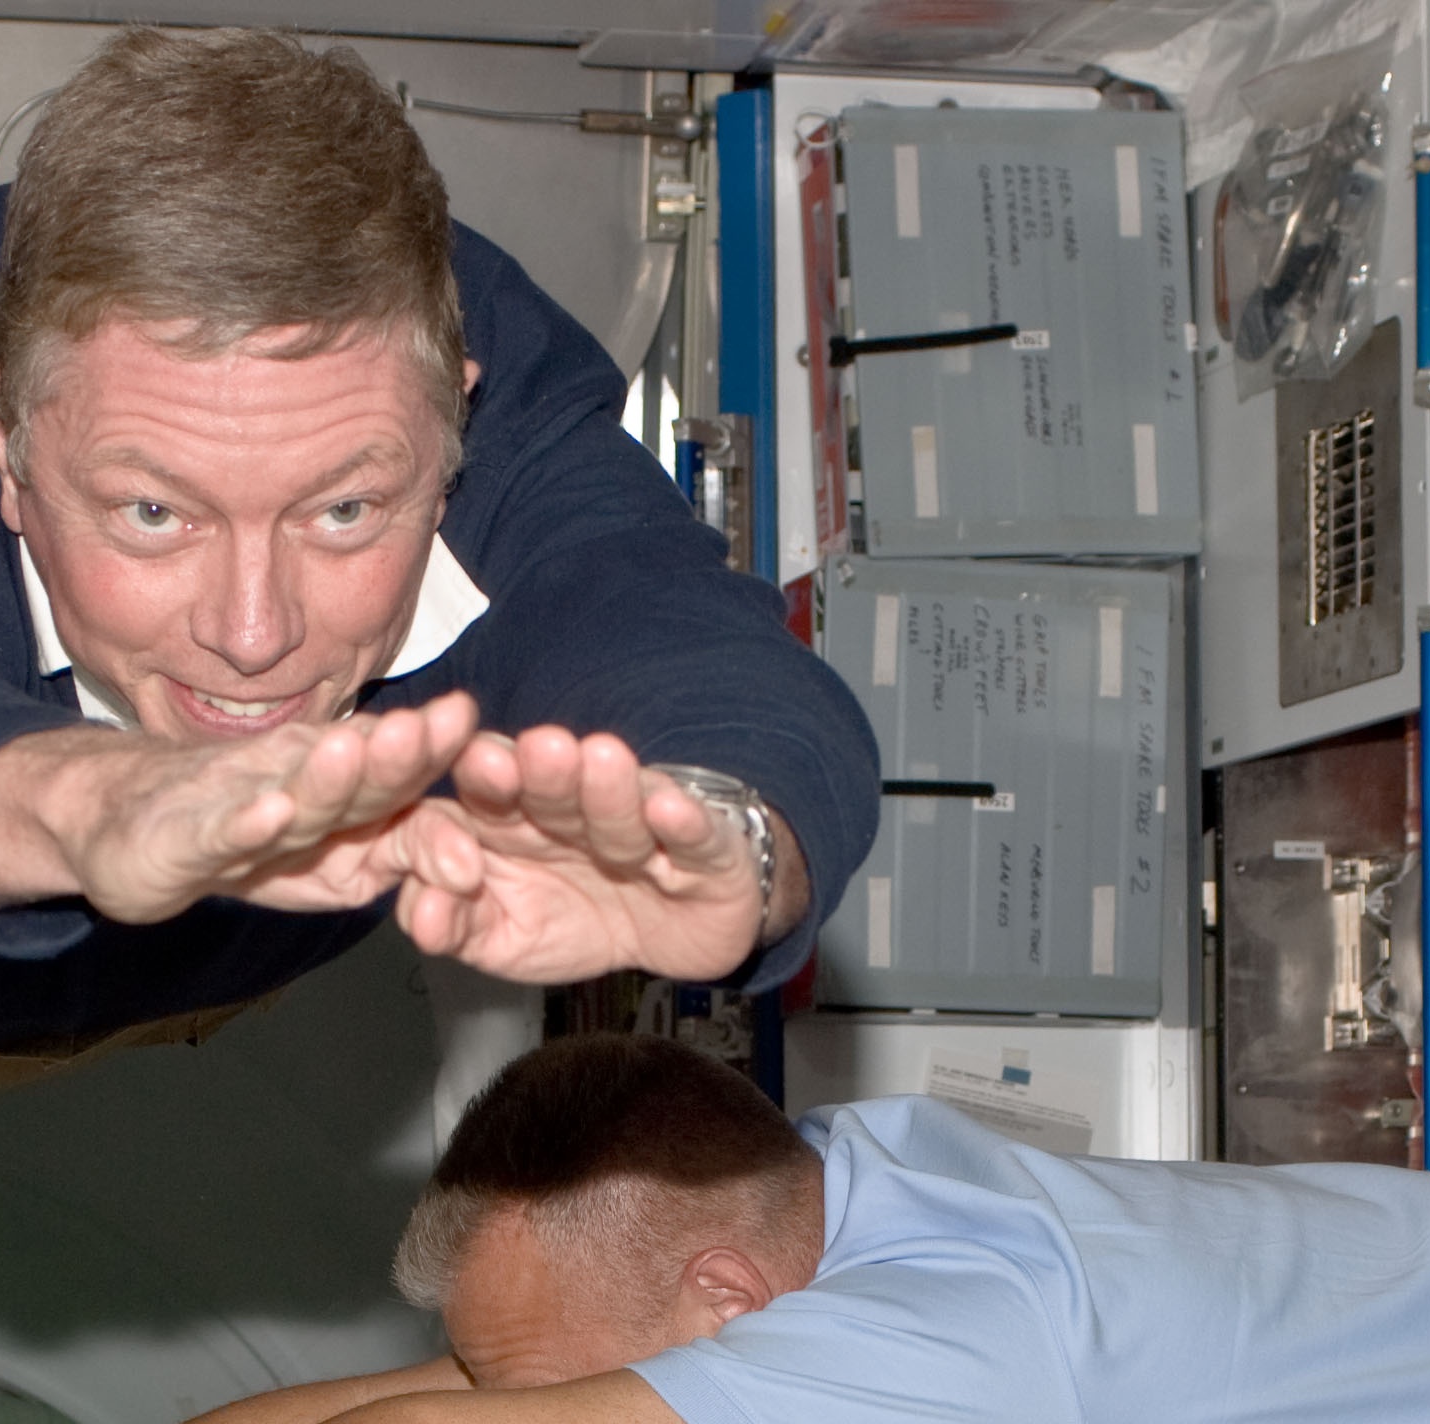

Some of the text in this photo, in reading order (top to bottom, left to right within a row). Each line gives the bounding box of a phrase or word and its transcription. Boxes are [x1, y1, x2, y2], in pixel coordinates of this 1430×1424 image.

[1162, 285, 1177, 342] TOOLS
[1015, 613, 1028, 714] WIRE CUTTERS
[1033, 614, 1050, 710] GRIP TOOLS
[974, 669, 990, 717] FEET
[1138, 722, 1155, 778] SPARE
[1136, 791, 1152, 838] TOOLS
